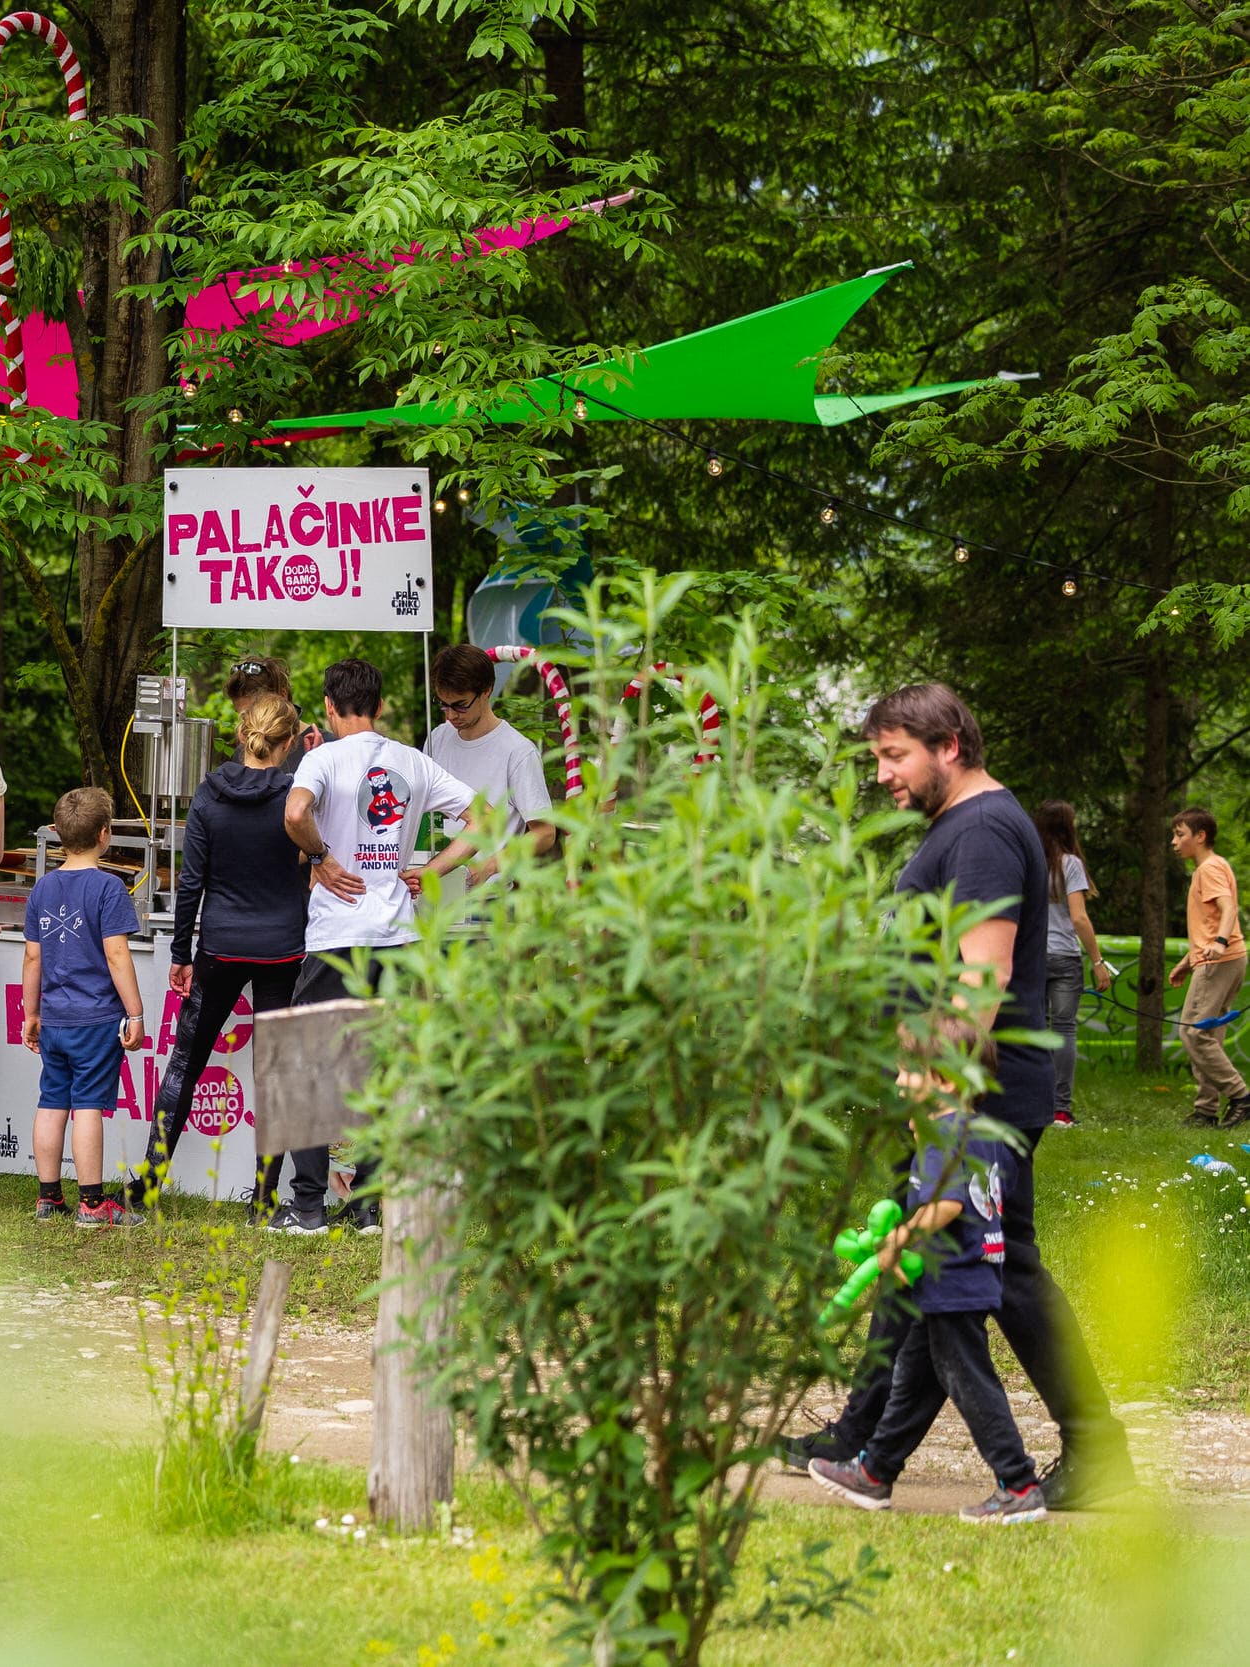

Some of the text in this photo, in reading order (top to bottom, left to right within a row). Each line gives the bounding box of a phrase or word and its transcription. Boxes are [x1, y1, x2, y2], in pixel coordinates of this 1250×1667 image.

[168, 484, 426, 555] PALAČINKE
[285, 561, 317, 575] DODAŠ
[199, 549, 361, 603] TAKOJ!
[285, 575, 317, 585] SAMO
[287, 585, 317, 596] VODO
[358, 843, 399, 852] THE DAYS
[354, 852, 377, 862] TEAM
[361, 861, 382, 870] AND
[191, 1097, 239, 1111] SAMO
[193, 1112, 237, 1127] VODO
